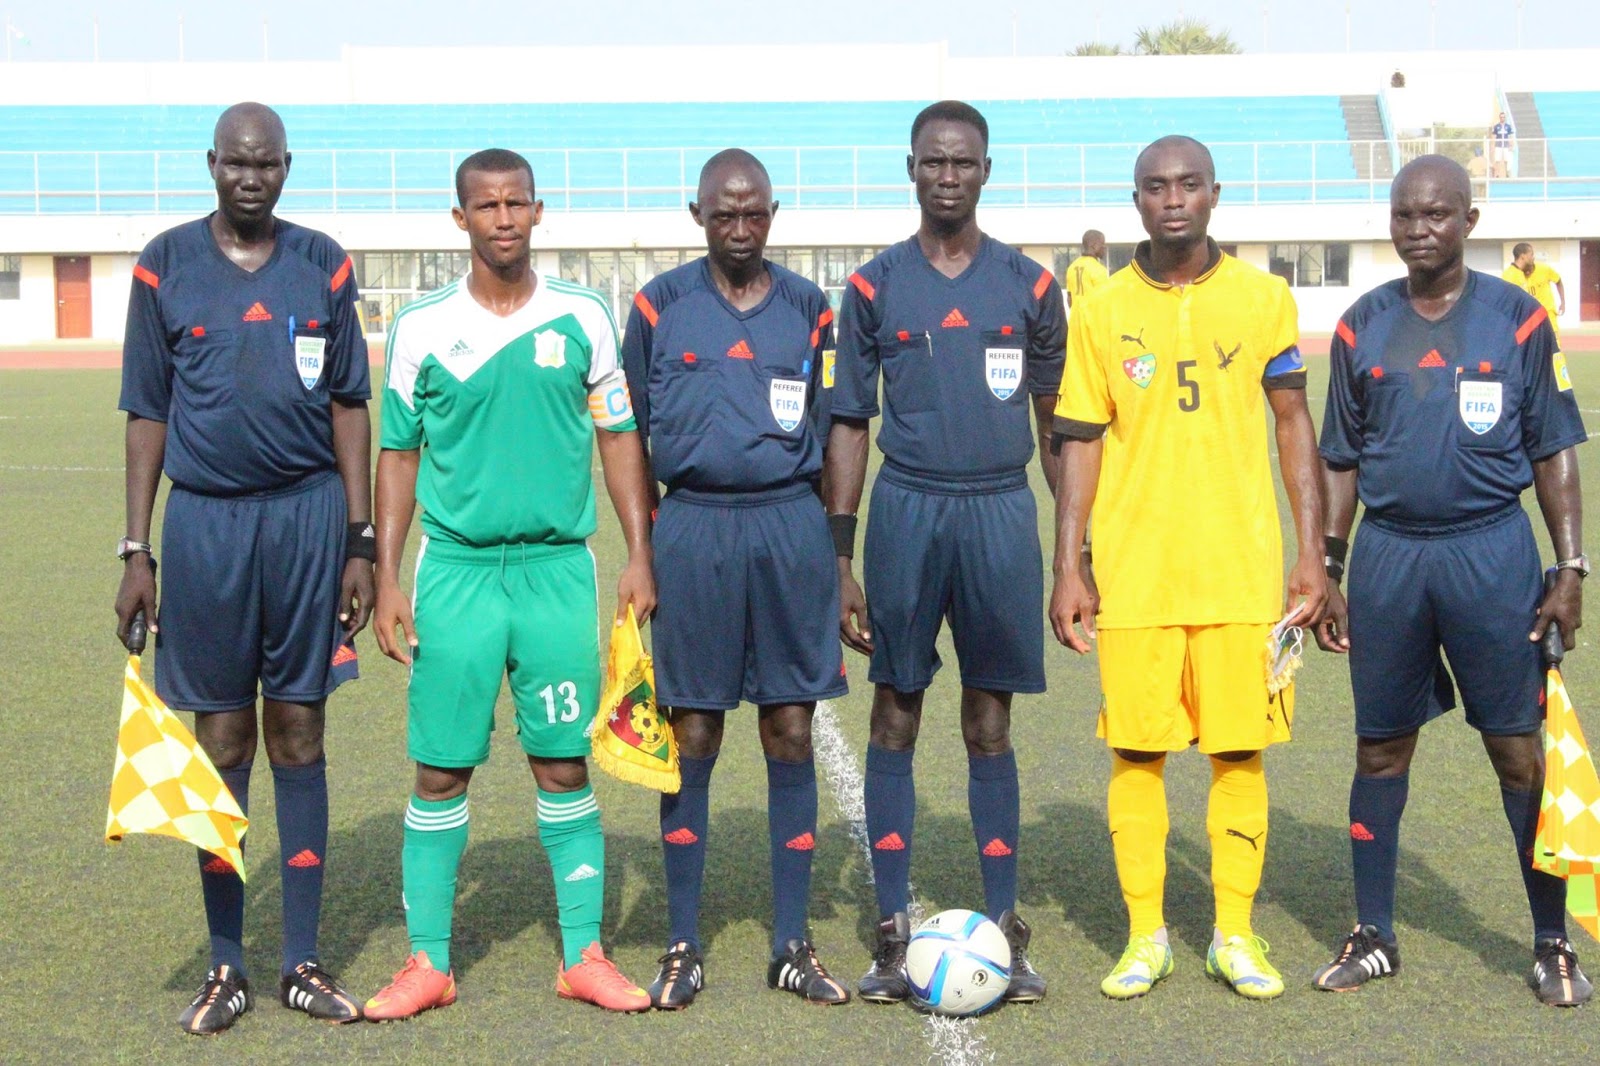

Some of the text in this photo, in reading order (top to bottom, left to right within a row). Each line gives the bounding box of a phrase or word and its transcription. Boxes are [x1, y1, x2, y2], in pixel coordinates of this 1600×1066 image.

[243, 313, 272, 321] adidas
[941, 319, 969, 328] adidas
[448, 349, 475, 358] adidas
[727, 350, 754, 360] adidas
[989, 352, 1020, 360] REFEREE
[300, 356, 319, 369] FIFA
[1418, 359, 1447, 368] adidas
[991, 368, 1017, 379] FIFA
[773, 383, 803, 393] REFEREE
[1176, 360, 1200, 412] 5
[606, 387, 628, 417] C
[776, 399, 800, 412] FIFA
[1466, 401, 1496, 413] FIFA
[539, 680, 581, 724] 13
[875, 842, 905, 851] adidas
[983, 847, 1012, 857] adidas
[288, 857, 320, 868] adidas
